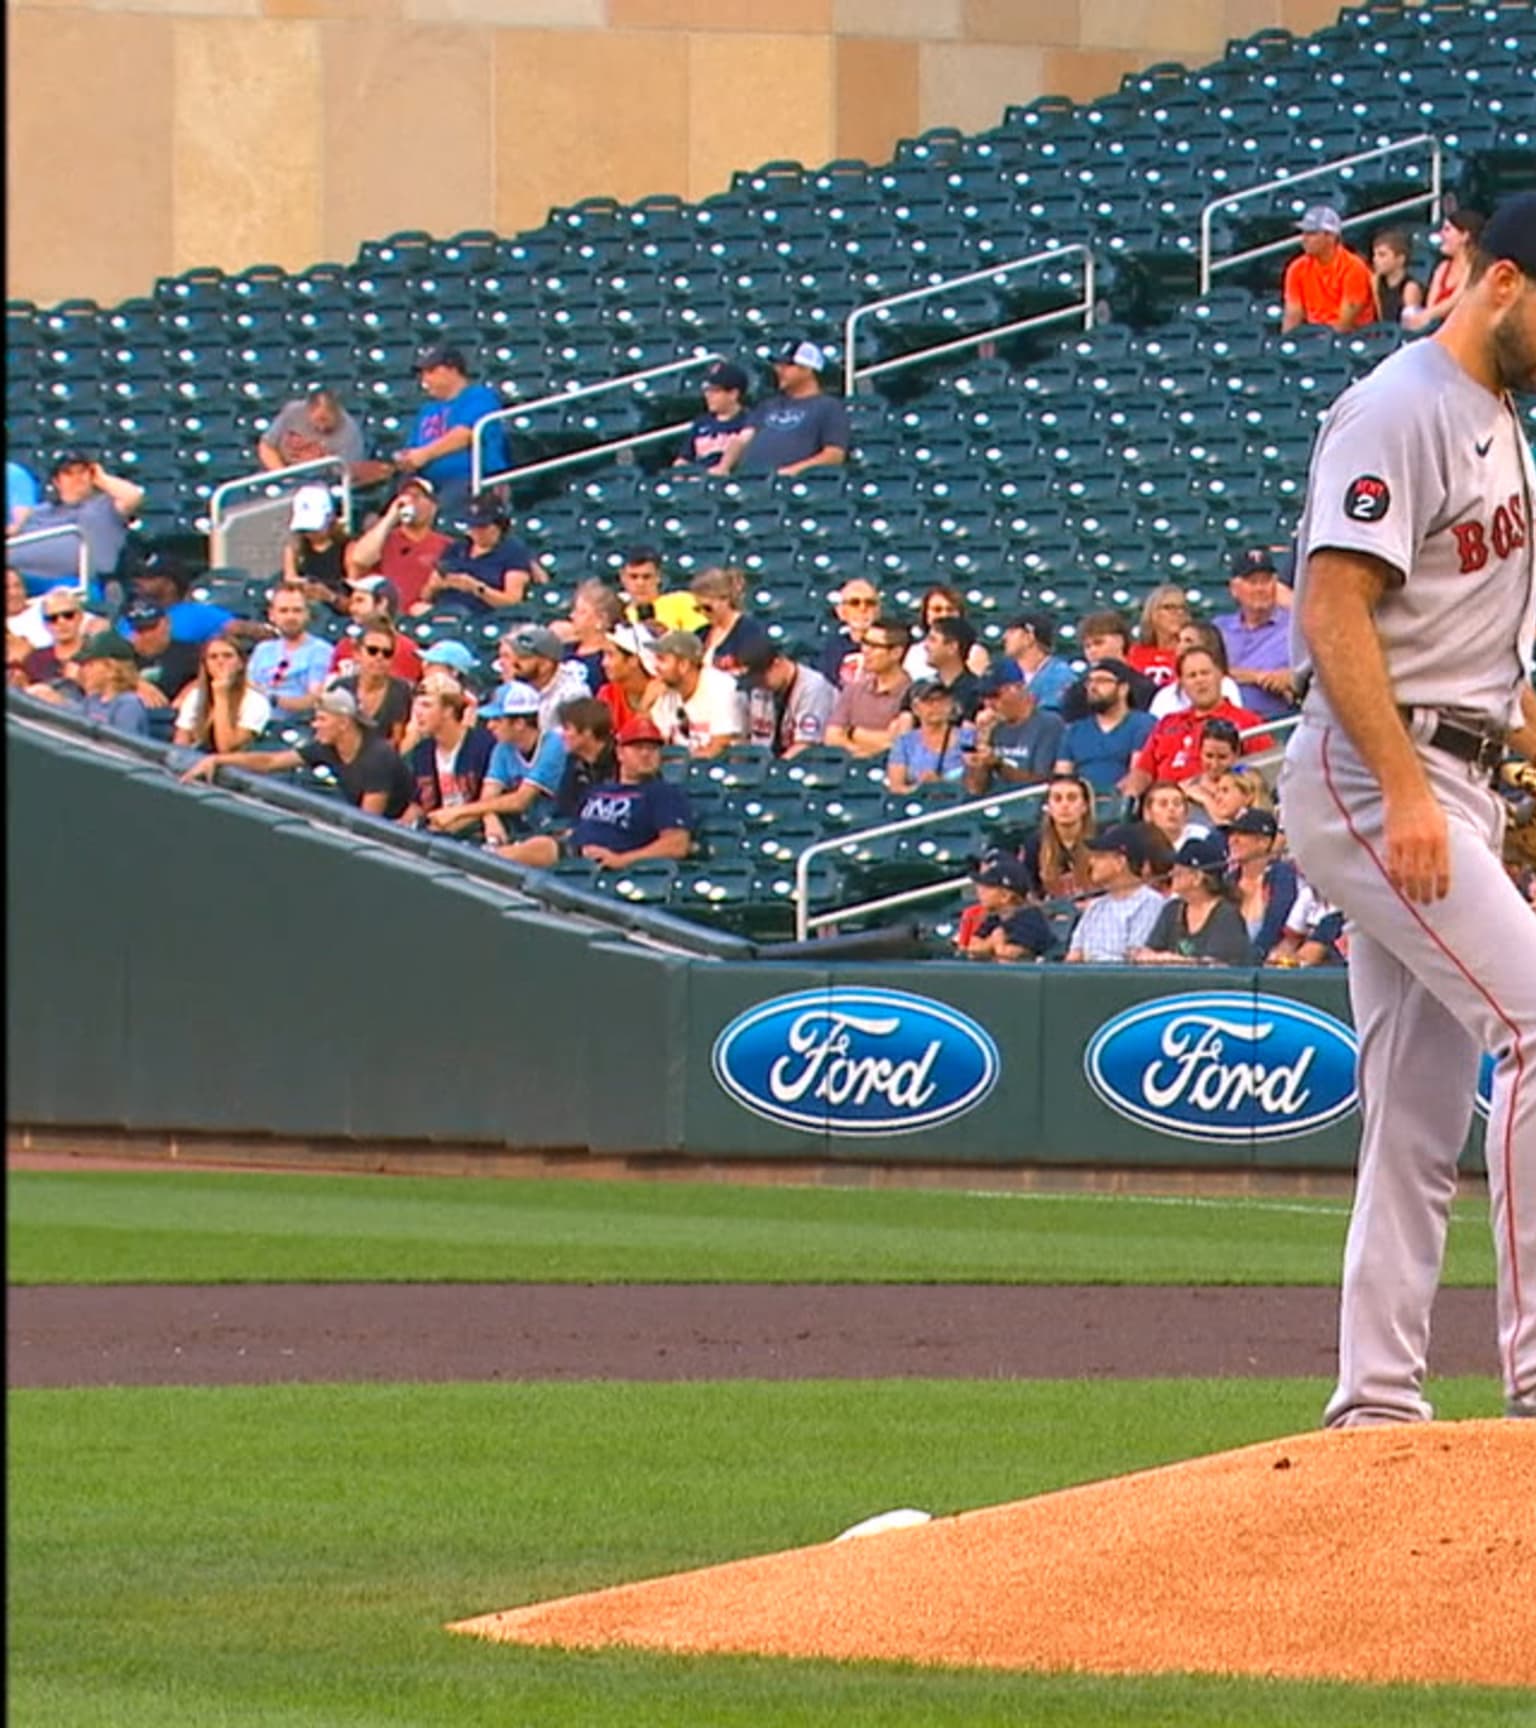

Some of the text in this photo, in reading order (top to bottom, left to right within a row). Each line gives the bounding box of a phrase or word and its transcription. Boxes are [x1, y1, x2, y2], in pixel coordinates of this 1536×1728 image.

[1353, 494, 1375, 518] 2
[770, 1009, 942, 1109] Ford
[1142, 1013, 1316, 1115] Ford
